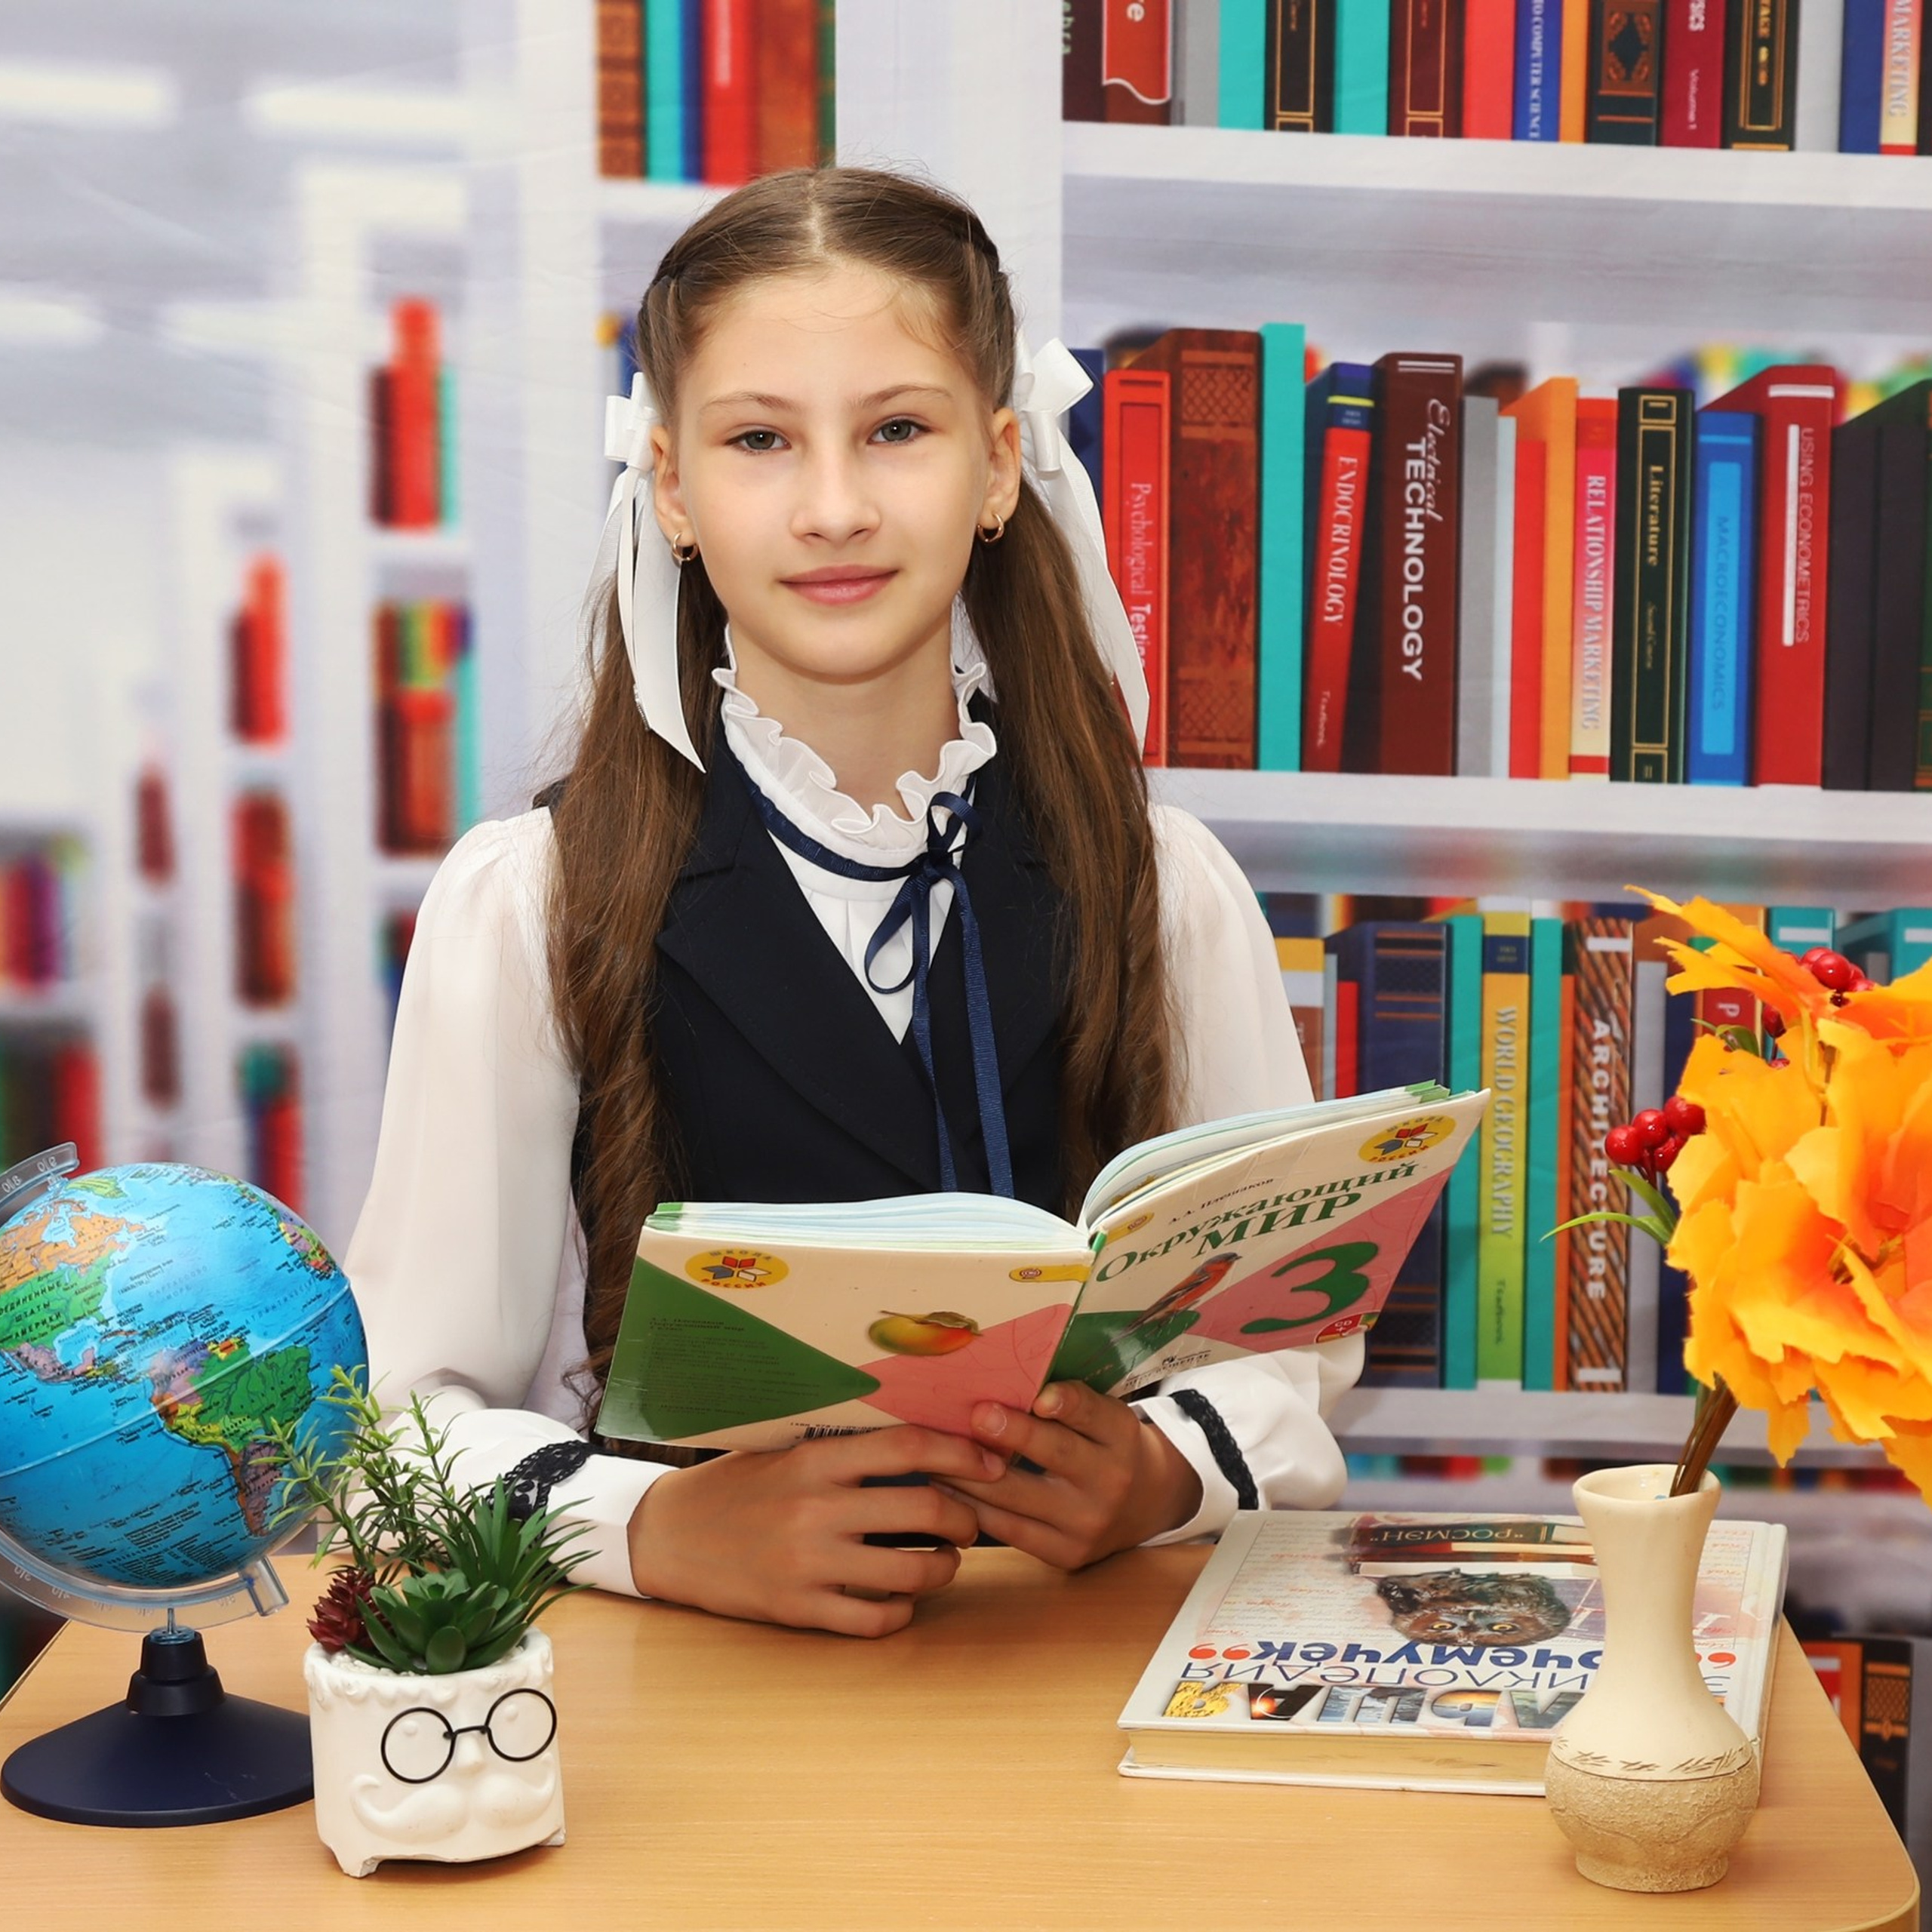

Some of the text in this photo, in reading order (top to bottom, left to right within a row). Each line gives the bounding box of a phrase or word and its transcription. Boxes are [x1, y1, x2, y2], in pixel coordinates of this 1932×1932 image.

[1424, 398, 1452, 521] Electrical
[1124, 483, 1152, 595] Psychological
[1323, 456, 1358, 626] ENDOCRINOLOGY
[1401, 439, 1426, 681] TECHNOLOGY
[1646, 465, 1663, 567] Literature
[1795, 427, 1815, 643] USING ECONOMETRICS
[1580, 475, 1606, 731] RELATIONSHIP MARKETING
[1712, 516, 1729, 712] MACROECONOMICS
[1491, 1006, 1518, 1239] WORLD GEOGRAPHY
[1587, 1019, 1611, 1300] ARCHITECURE
[1096, 1160, 1420, 1283] Окружающий
[1192, 1192, 1361, 1259] МИР
[14, 1301, 51, 1323] ШТАТЫ
[14, 1312, 61, 1339] АМЕРИКИ
[700, 1277, 768, 1289] РОССИИ
[1240, 1241, 1379, 1334] 3
[1334, 1319, 1353, 1328] CD
[1370, 1526, 1523, 1544] "РОСМЭН"
[1163, 1681, 1727, 1729] ЛЬШАЯ
